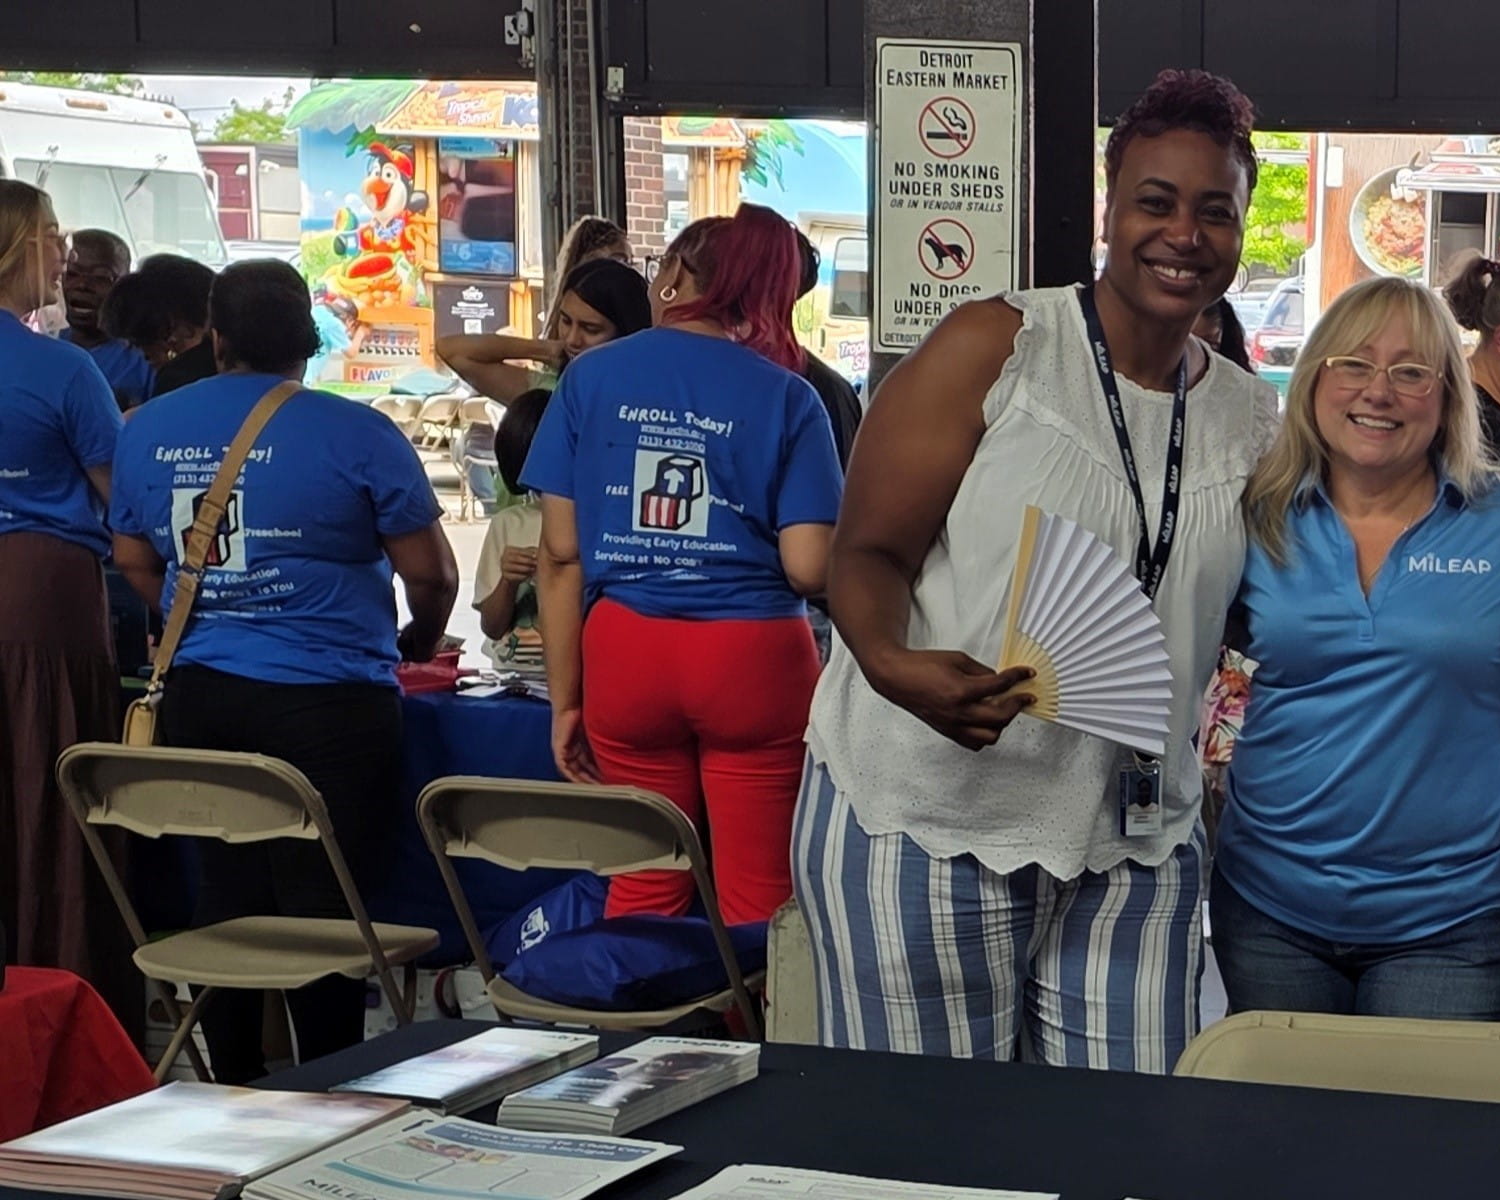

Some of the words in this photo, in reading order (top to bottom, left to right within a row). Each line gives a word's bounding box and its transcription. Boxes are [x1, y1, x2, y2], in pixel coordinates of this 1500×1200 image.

[920, 51, 974, 69] DETROIT
[887, 69, 946, 88] EASTERN
[952, 72, 1009, 91] MARKET
[894, 161, 916, 176] NO
[923, 163, 1000, 180] SMOKING
[889, 181, 942, 197] UNDER
[950, 183, 1005, 199] SHEDS
[890, 198, 904, 208] OR
[907, 199, 919, 209] IN
[923, 200, 963, 212] VENDOR
[966, 202, 1004, 213] STALLS
[910, 283, 931, 298] NO
[894, 300, 942, 316] UNDER
[894, 317, 907, 326] OR
[909, 317, 919, 326] IN
[618, 405, 677, 422] ENROLL
[684, 411, 733, 437] Today!
[155, 446, 213, 463] ENROLL
[602, 532, 651, 548] Providing
[653, 537, 680, 551] Early
[682, 540, 737, 552] Education
[594, 550, 635, 563] Services
[637, 555, 649, 563] at
[653, 556, 670, 565] NO
[1409, 552, 1492, 574] MiLEAP
[224, 567, 280, 584] Education
